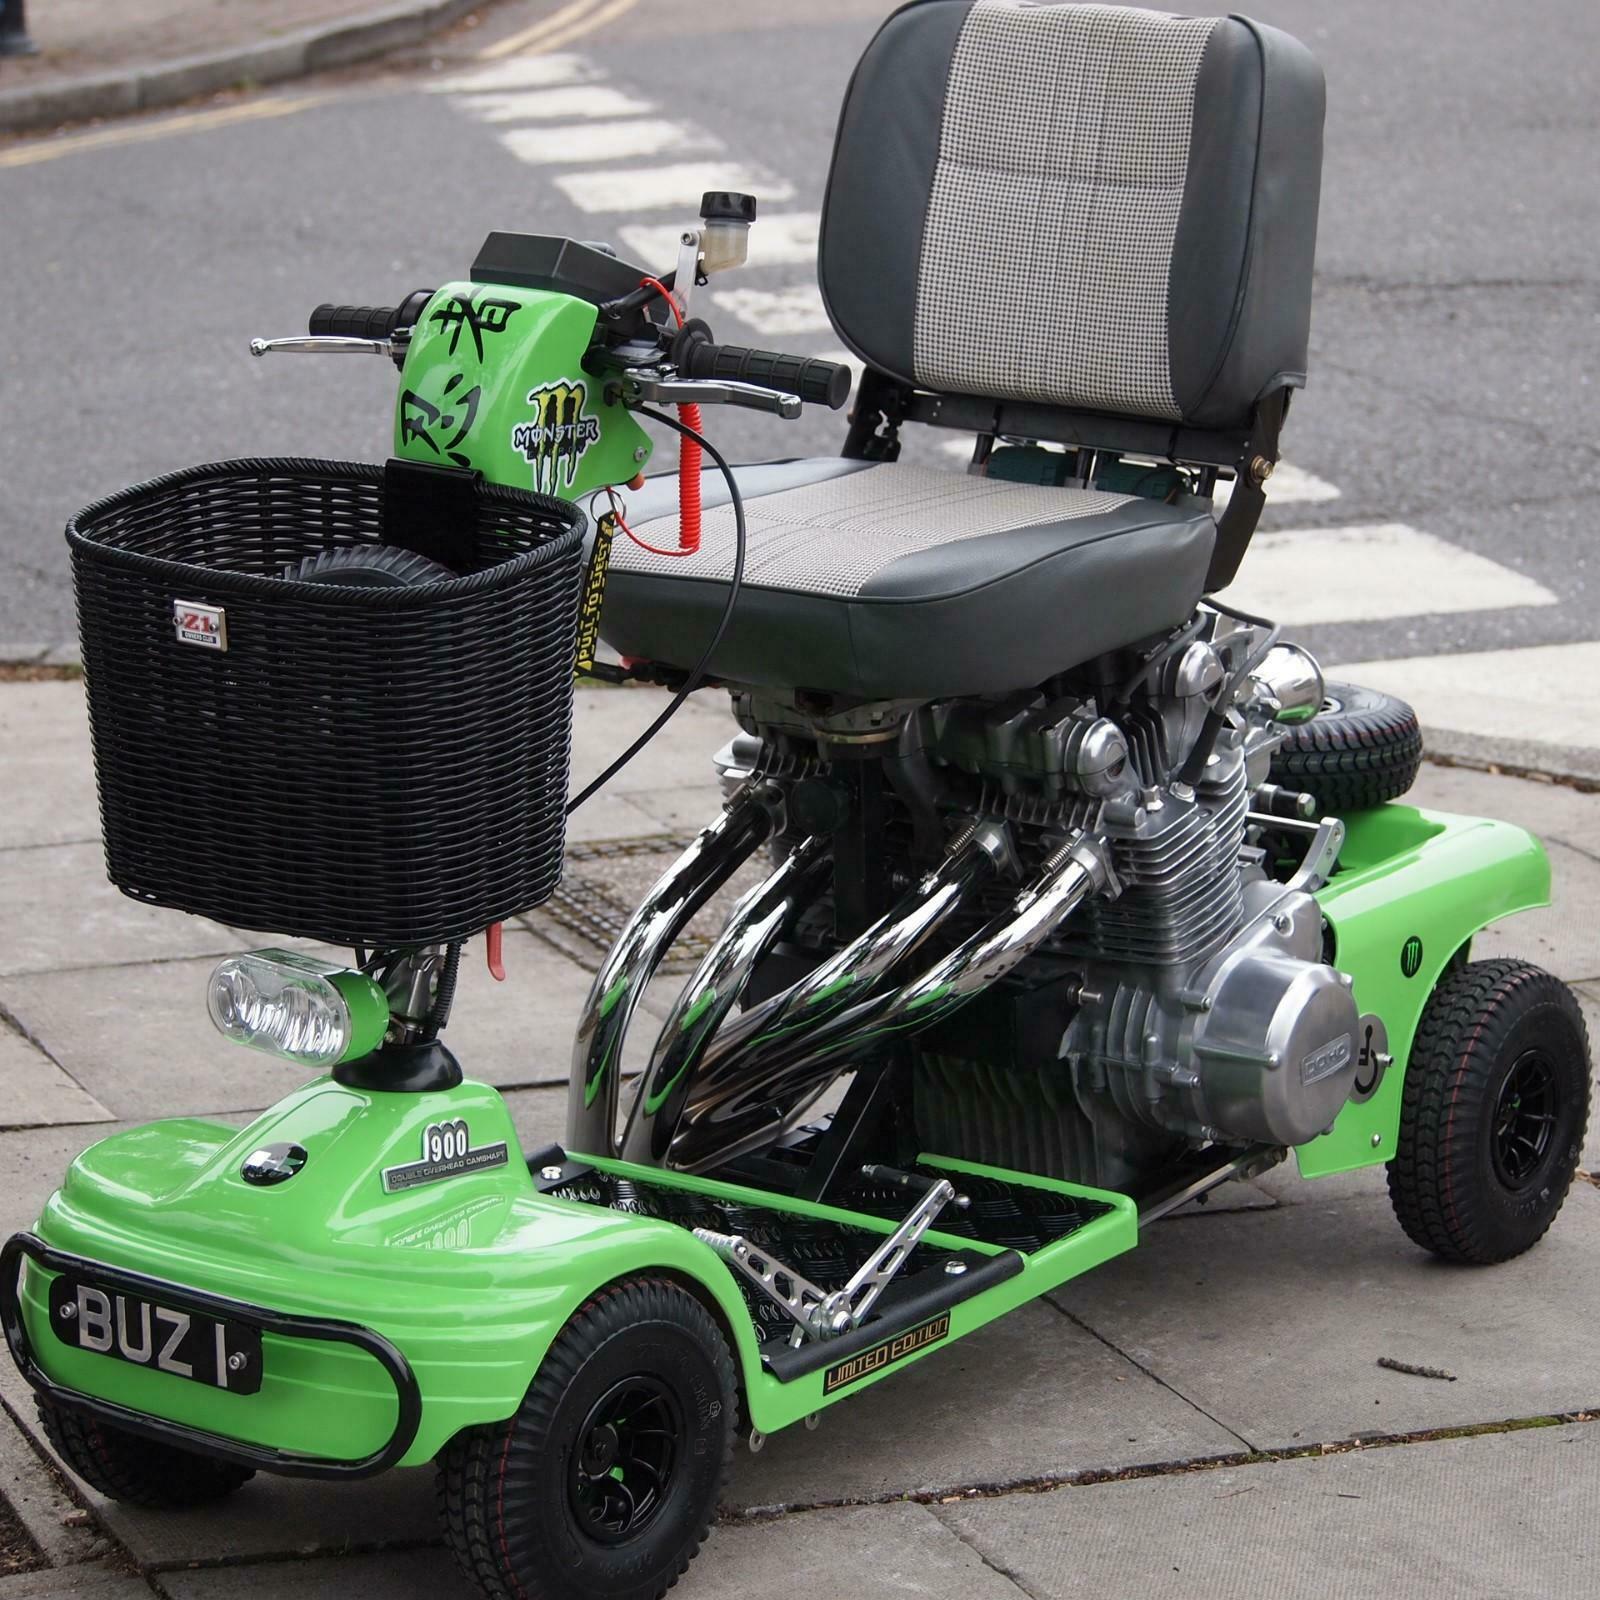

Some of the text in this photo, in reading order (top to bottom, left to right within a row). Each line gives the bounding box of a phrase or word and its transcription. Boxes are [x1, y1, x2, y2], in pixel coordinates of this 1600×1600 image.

[401, 288, 522, 467] 忍者
[514, 421, 598, 448] MONSTER
[184, 612, 210, 633] Z1
[579, 537, 609, 660] PULL TO EJECT
[391, 1150, 505, 1183] DOUBLE OVERHEAD CAMSHAFT
[430, 1129, 467, 1162] 900
[77, 1284, 192, 1377] BUZ
[827, 1317, 949, 1389] LIMITED EDITION
